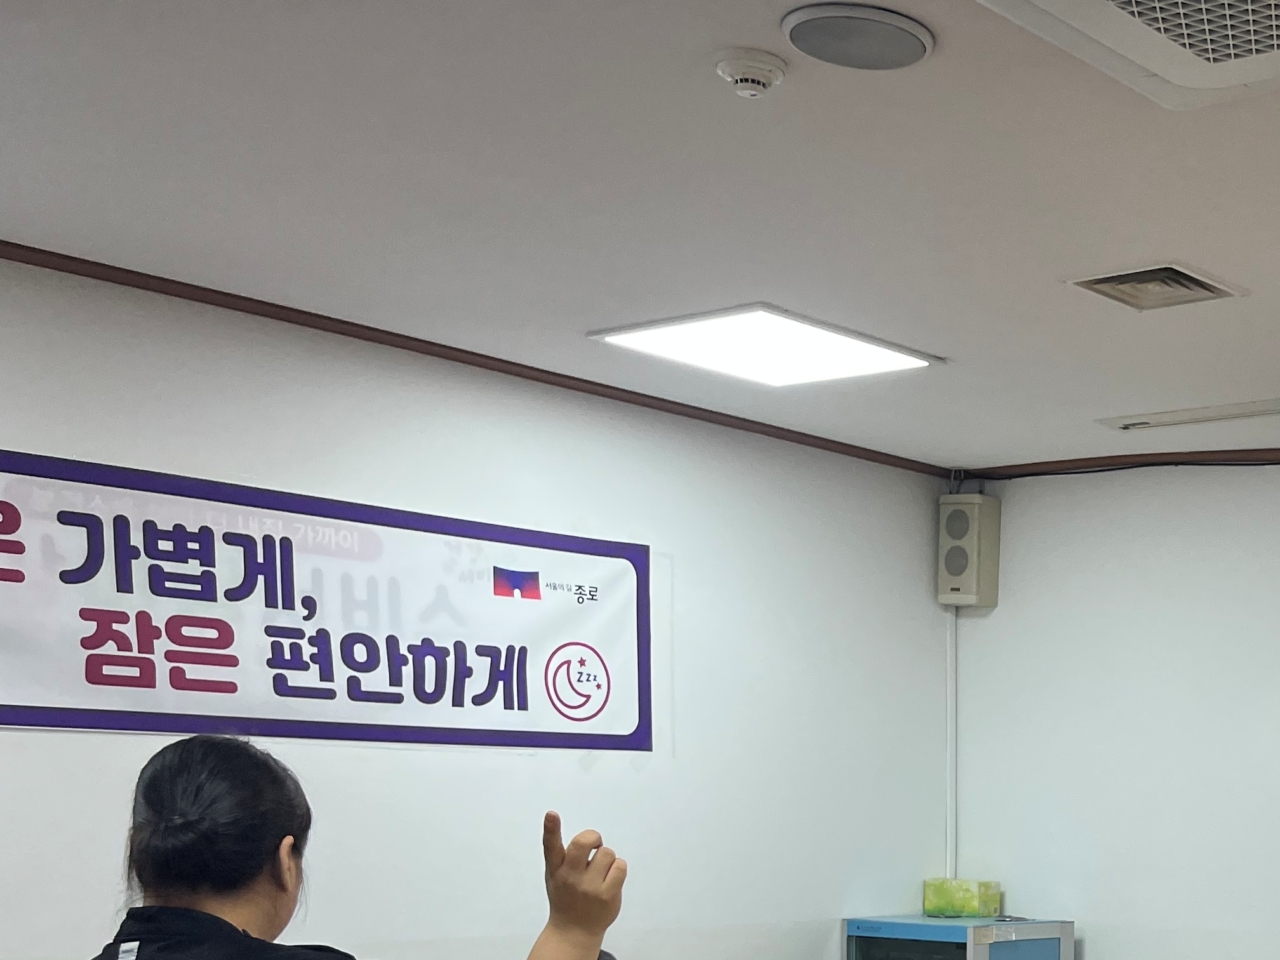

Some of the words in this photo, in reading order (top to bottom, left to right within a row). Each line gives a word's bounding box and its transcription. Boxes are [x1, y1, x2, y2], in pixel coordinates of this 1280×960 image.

[57, 509, 317, 621] 가볍게,
[573, 584, 599, 605] 종로
[79, 607, 240, 694] 잠은
[264, 625, 529, 711] 편안하게
